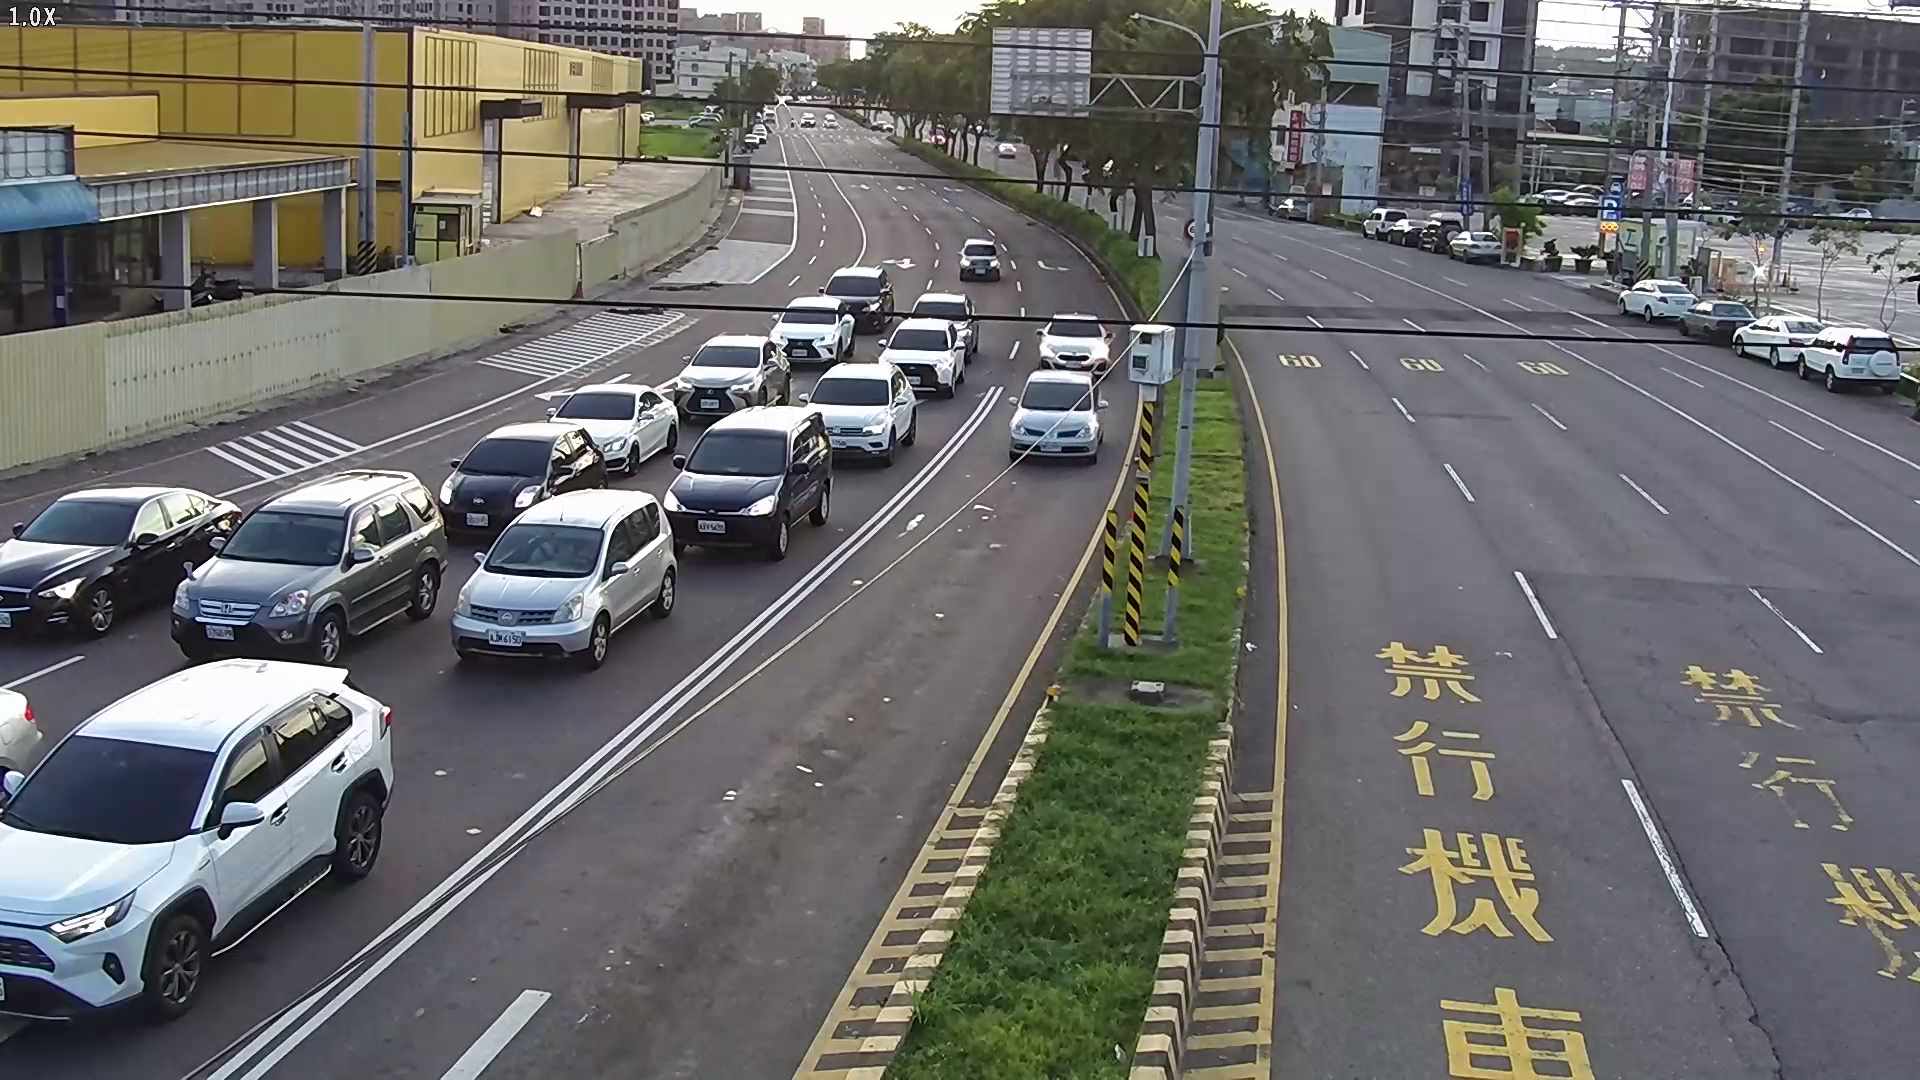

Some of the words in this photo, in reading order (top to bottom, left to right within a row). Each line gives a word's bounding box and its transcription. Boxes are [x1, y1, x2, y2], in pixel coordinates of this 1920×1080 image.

[1278, 354, 1322, 369] 60
[1400, 358, 1445, 372] 60
[1517, 361, 1569, 375] 60
